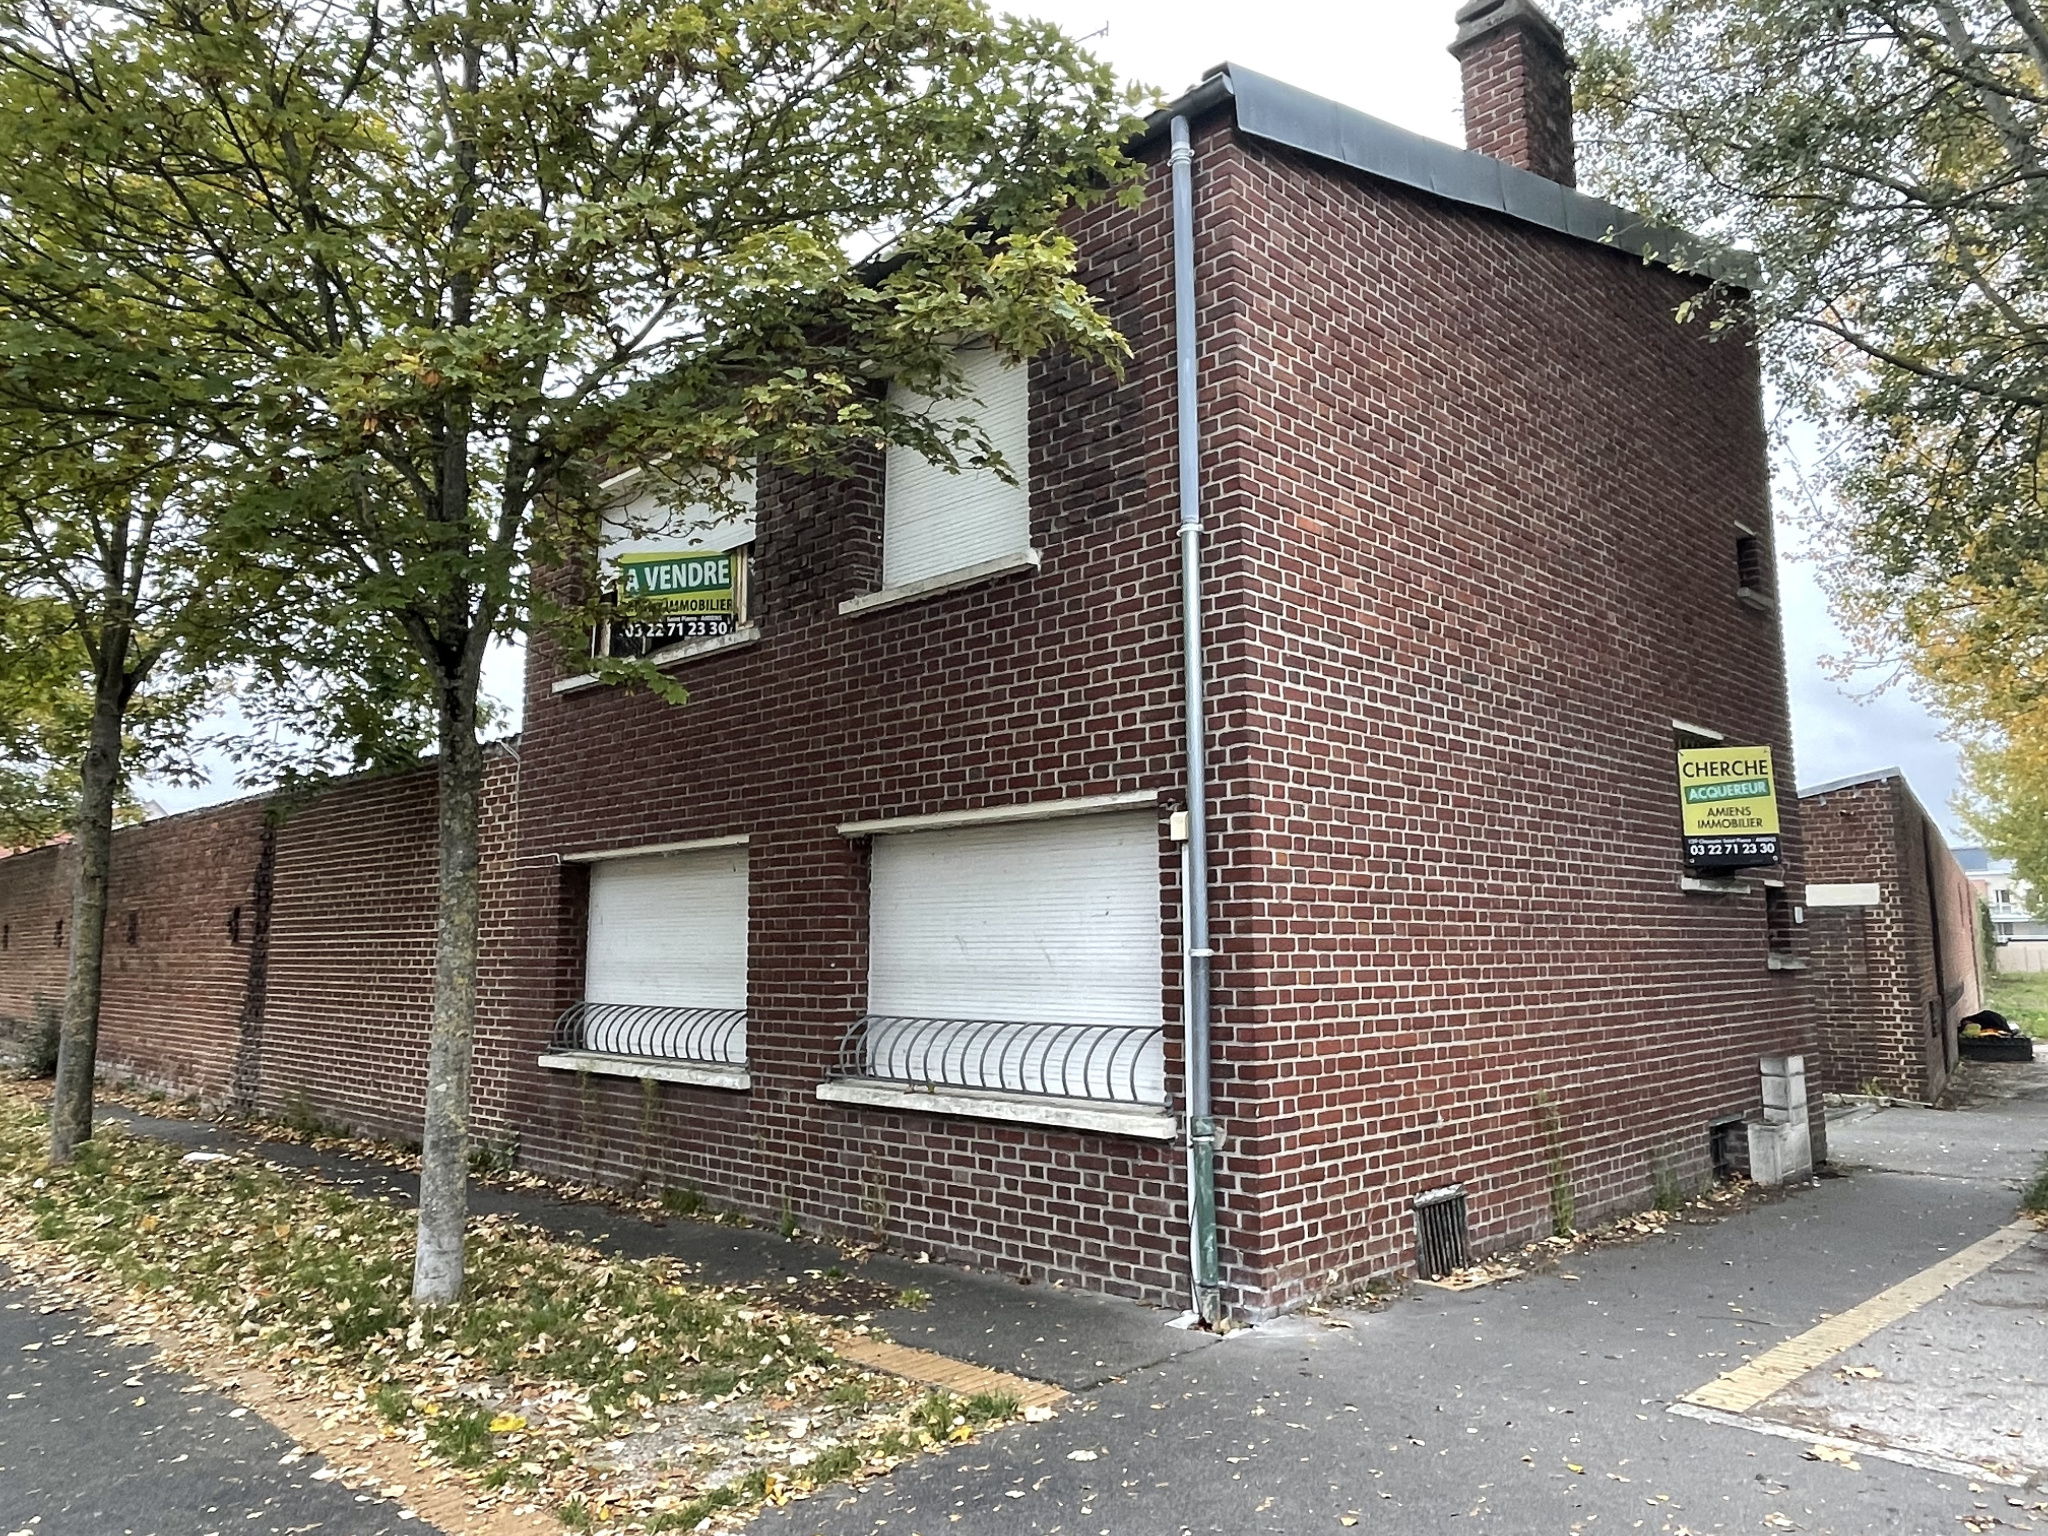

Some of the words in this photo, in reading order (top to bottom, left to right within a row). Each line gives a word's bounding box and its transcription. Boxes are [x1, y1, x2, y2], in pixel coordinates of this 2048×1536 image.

[625, 568, 640, 592] A
[644, 559, 730, 591] VENDRE
[625, 623, 643, 638] 03
[646, 622, 664, 637] 22
[667, 622, 683, 637] 71
[688, 621, 706, 636] 23
[709, 621, 728, 635] 30
[1682, 760, 1769, 778] CHERCHE
[1688, 781, 1767, 801] ACQUEREUR
[1707, 806, 1752, 817] AMIENS
[1697, 817, 1763, 829] IMMOBILIER
[1690, 844, 1705, 856] 03
[1707, 844, 1722, 855] 22
[1725, 844, 1738, 855] 71
[1742, 843, 1757, 854] 23
[1759, 842, 1775, 854] 30
